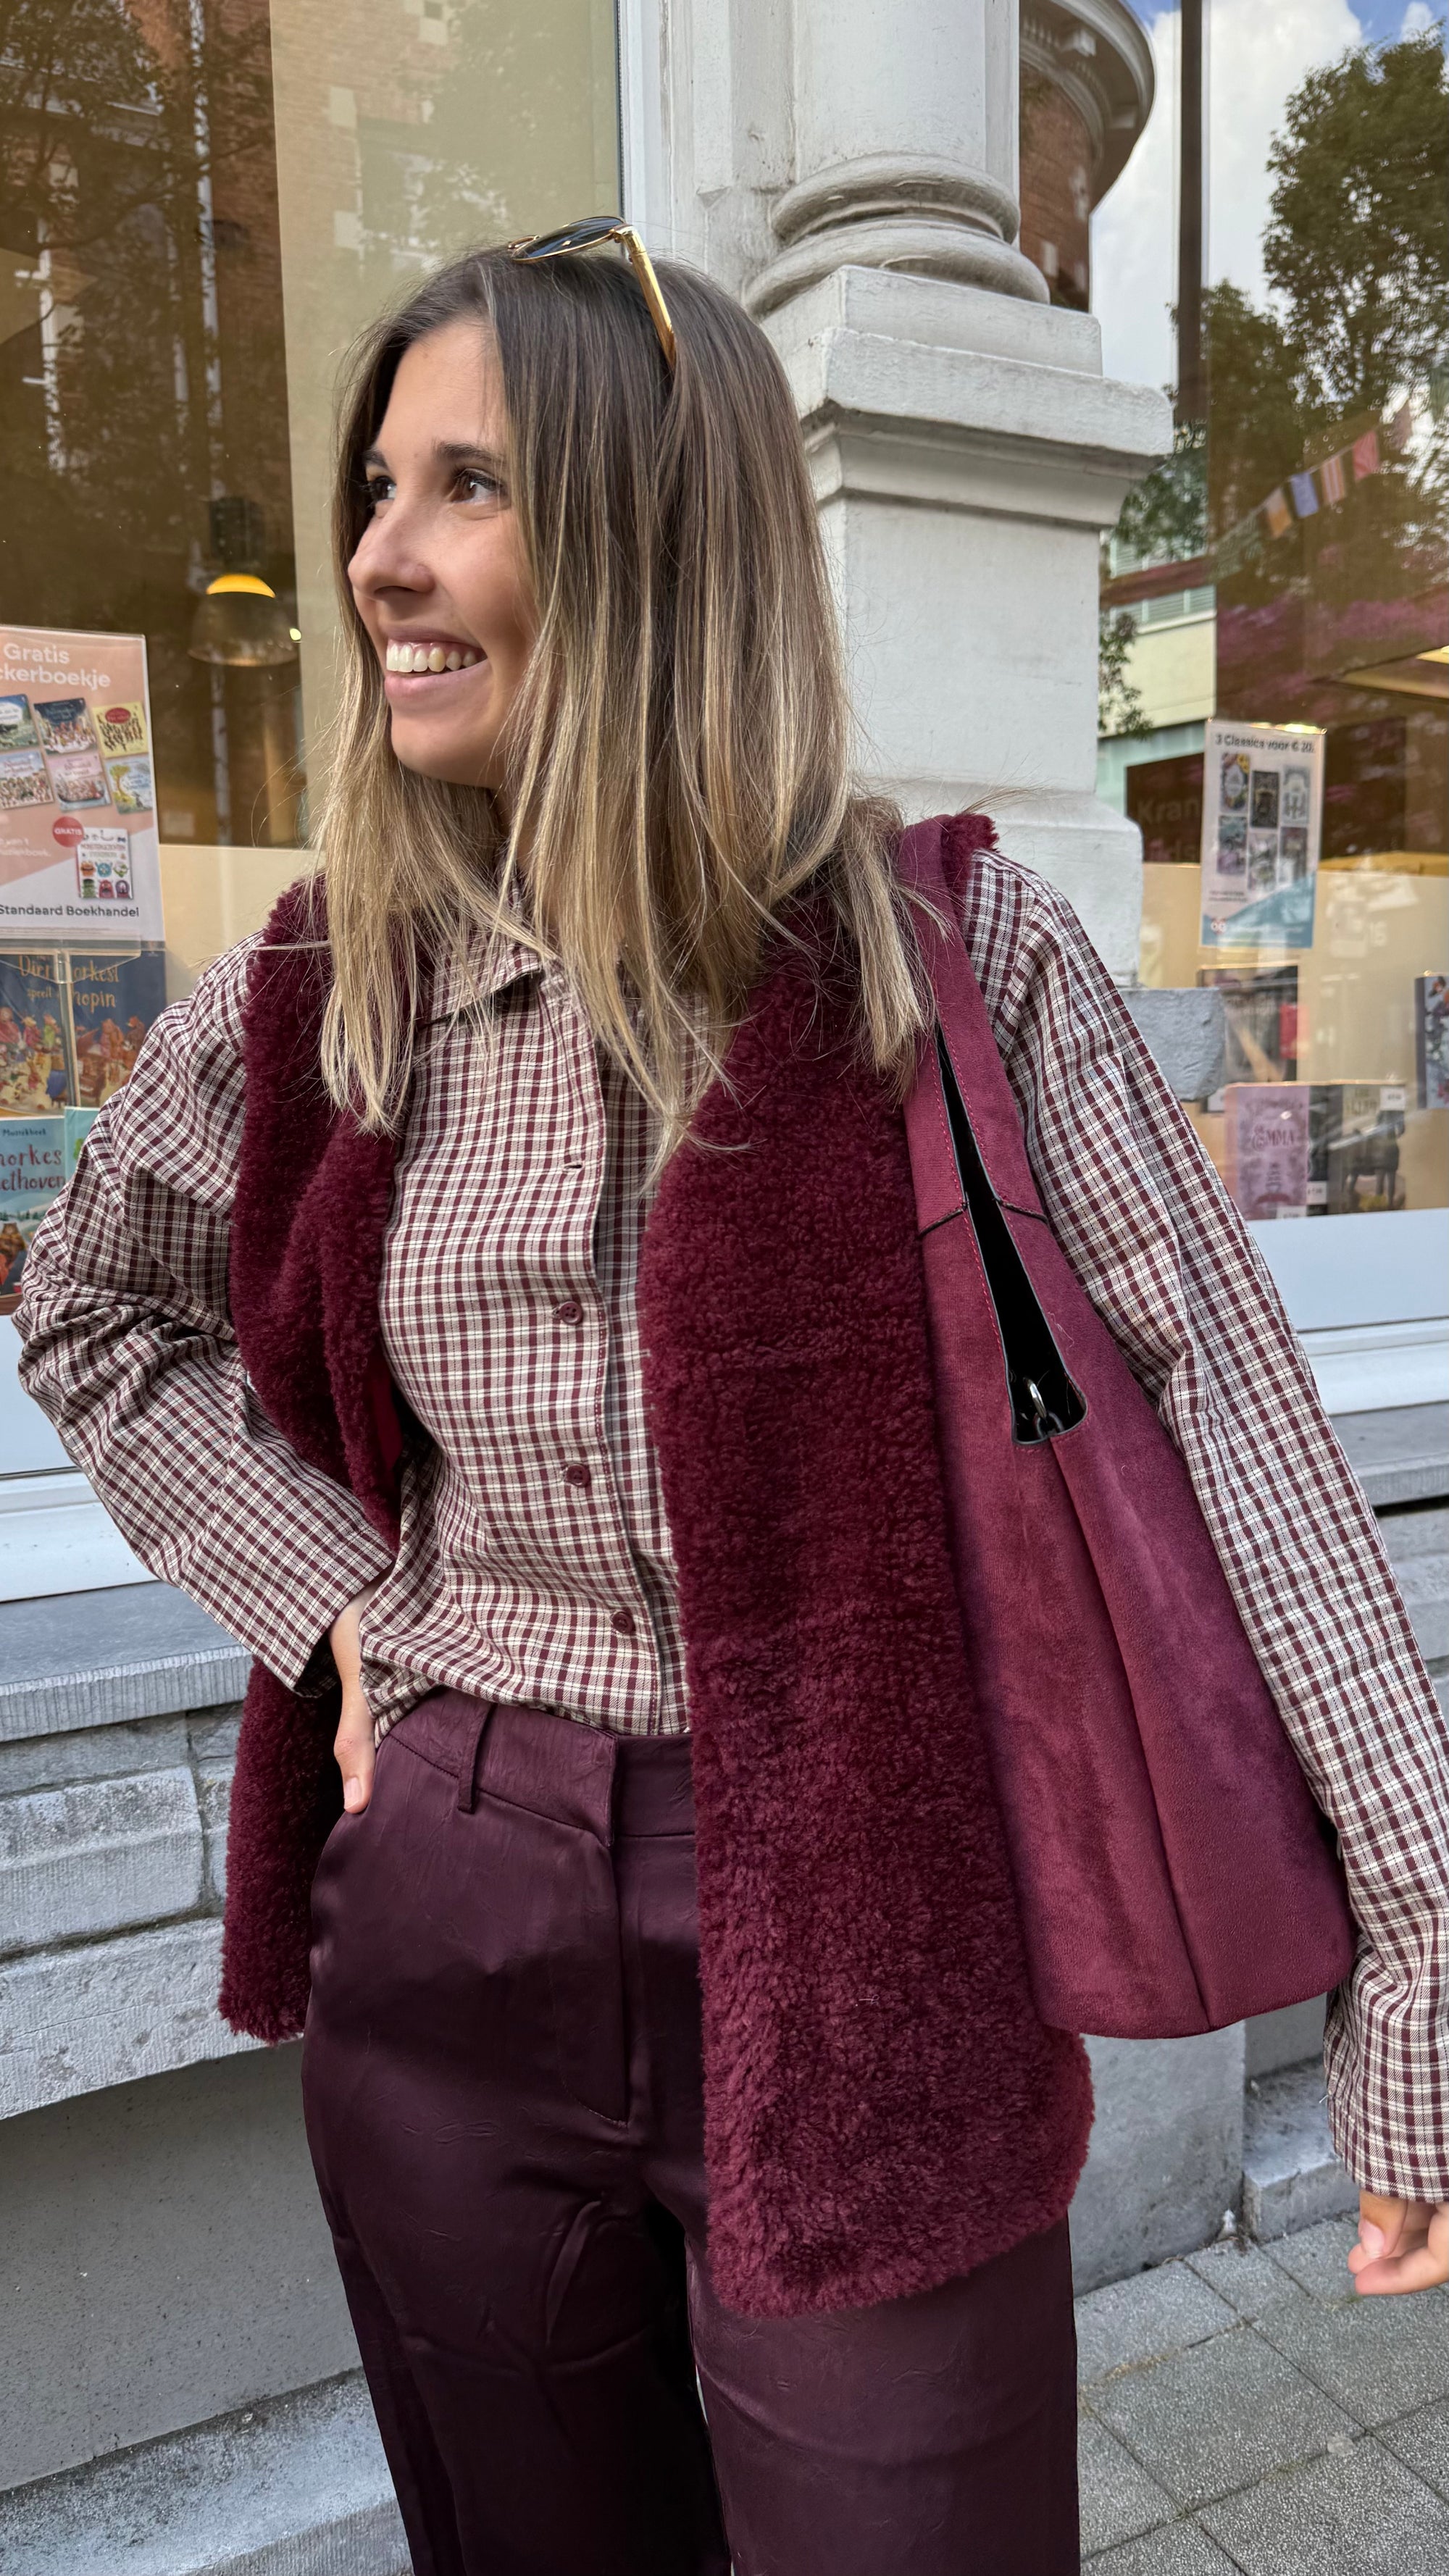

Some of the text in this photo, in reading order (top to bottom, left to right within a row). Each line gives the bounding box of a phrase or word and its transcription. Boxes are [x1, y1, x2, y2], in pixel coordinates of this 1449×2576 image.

[4, 643, 70, 664] Gratis
[1224, 735, 1265, 749] Classics
[1268, 740, 1289, 750] voor
[66, 906, 139, 917] Boekhandel
[1252, 1124, 1295, 1151] EMMA
